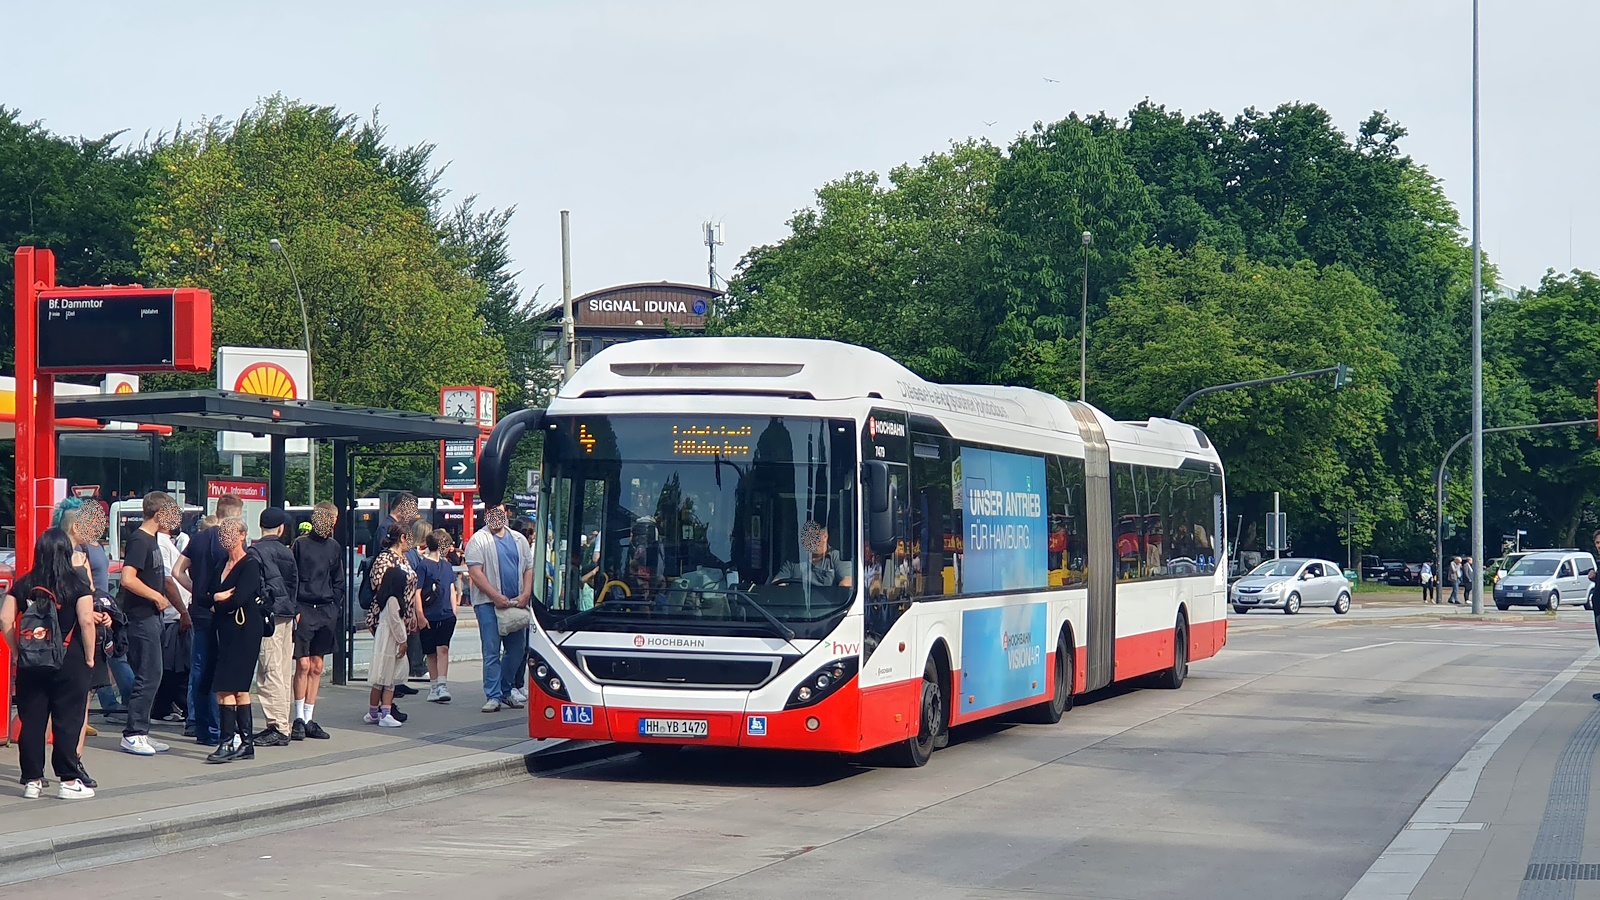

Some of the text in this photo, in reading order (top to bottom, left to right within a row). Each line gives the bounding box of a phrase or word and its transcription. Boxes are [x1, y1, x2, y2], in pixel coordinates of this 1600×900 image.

[49, 299, 103, 309] Bf. Dammtor
[590, 299, 687, 313] SIGNAL IDUNA
[875, 420, 905, 437] HOCHBAHN
[211, 483, 227, 496] hvv
[230, 486, 258, 496] Information
[969, 489, 1003, 516] UNSER
[1004, 491, 1041, 518] ANTRIEB
[970, 518, 1031, 551] FÜR HAMBURG.
[648, 637, 705, 648] HOCHBAHN
[1008, 632, 1032, 647] HOCHBAHN
[832, 640, 860, 655] hvv
[646, 720, 707, 734] HH YB 1479
